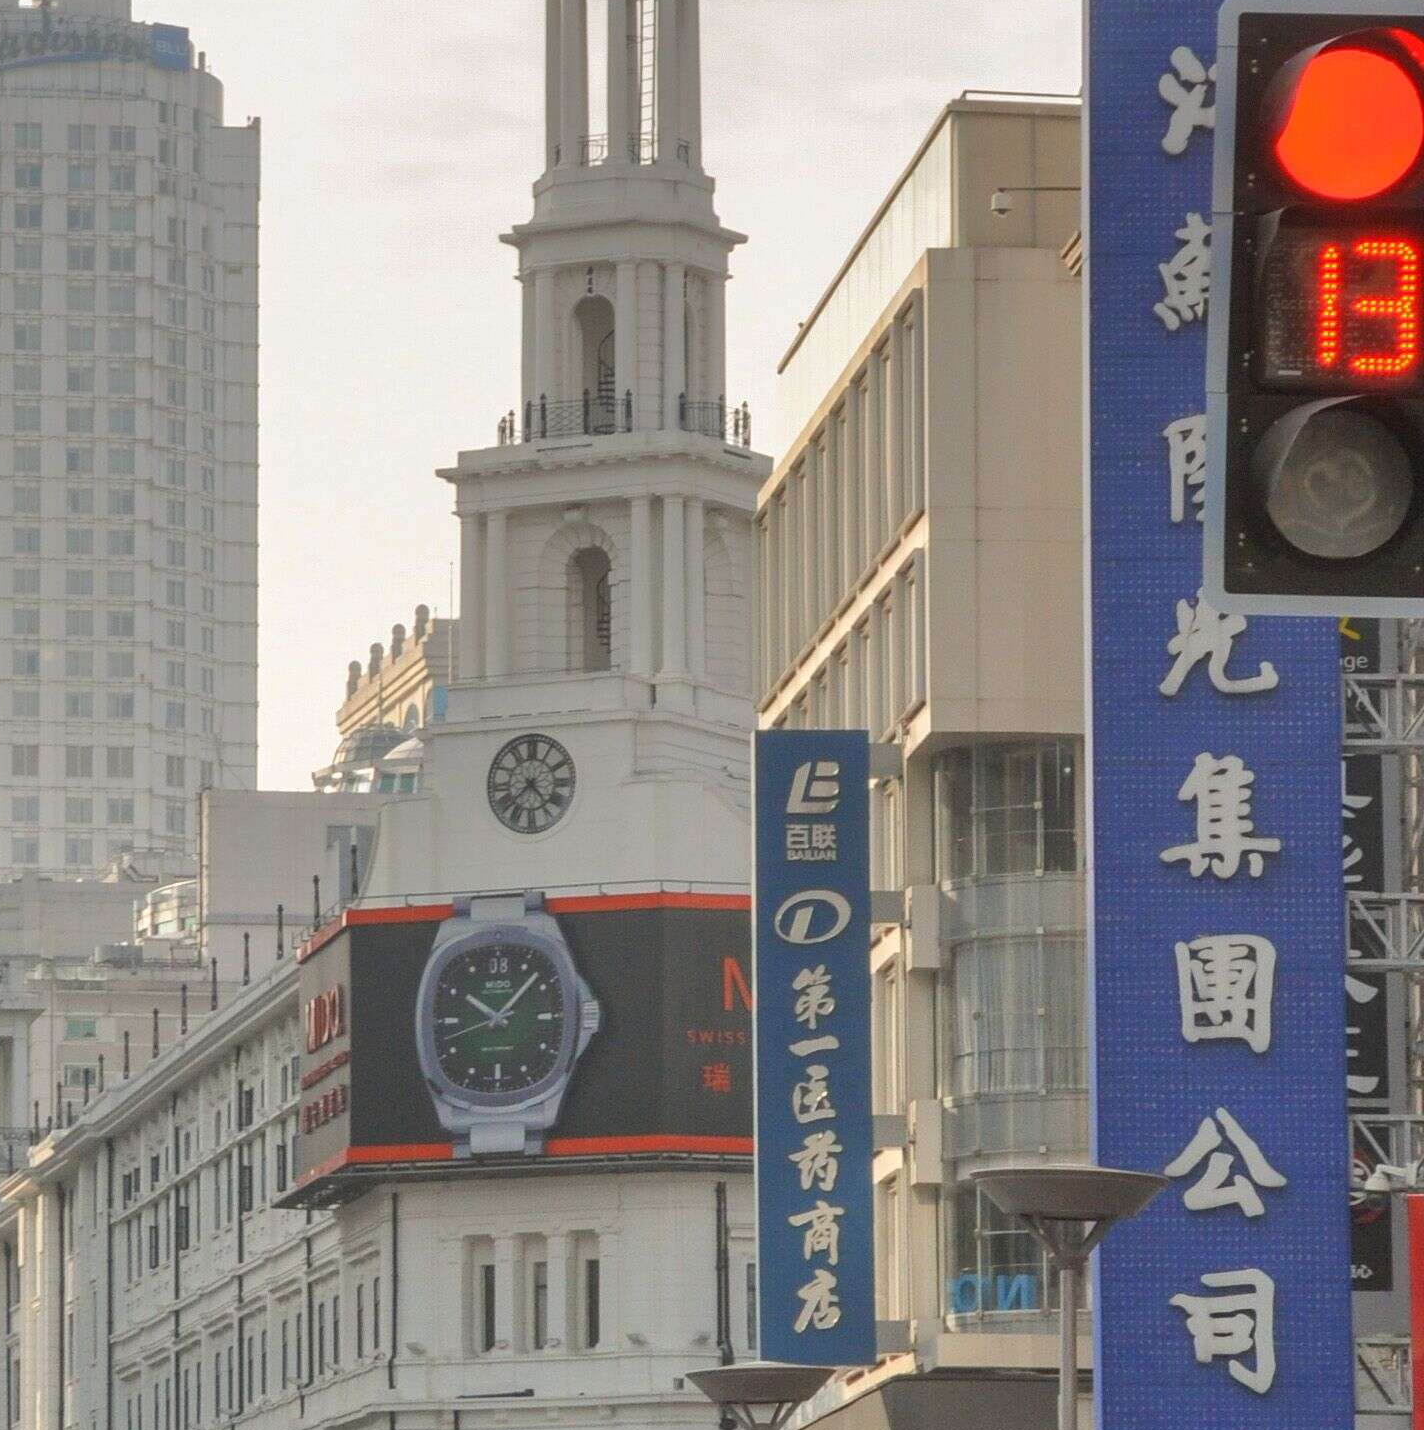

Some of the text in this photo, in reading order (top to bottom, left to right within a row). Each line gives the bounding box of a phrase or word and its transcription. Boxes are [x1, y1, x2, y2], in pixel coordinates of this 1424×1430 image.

[1318, 241, 1418, 374] 13
[1339, 655, 1369, 672] ge
[786, 823, 836, 849] 百联
[787, 850, 836, 861] BAILIAN
[687, 1030, 746, 1045] SWISS
[789, 965, 845, 1333] 第一医药商店
